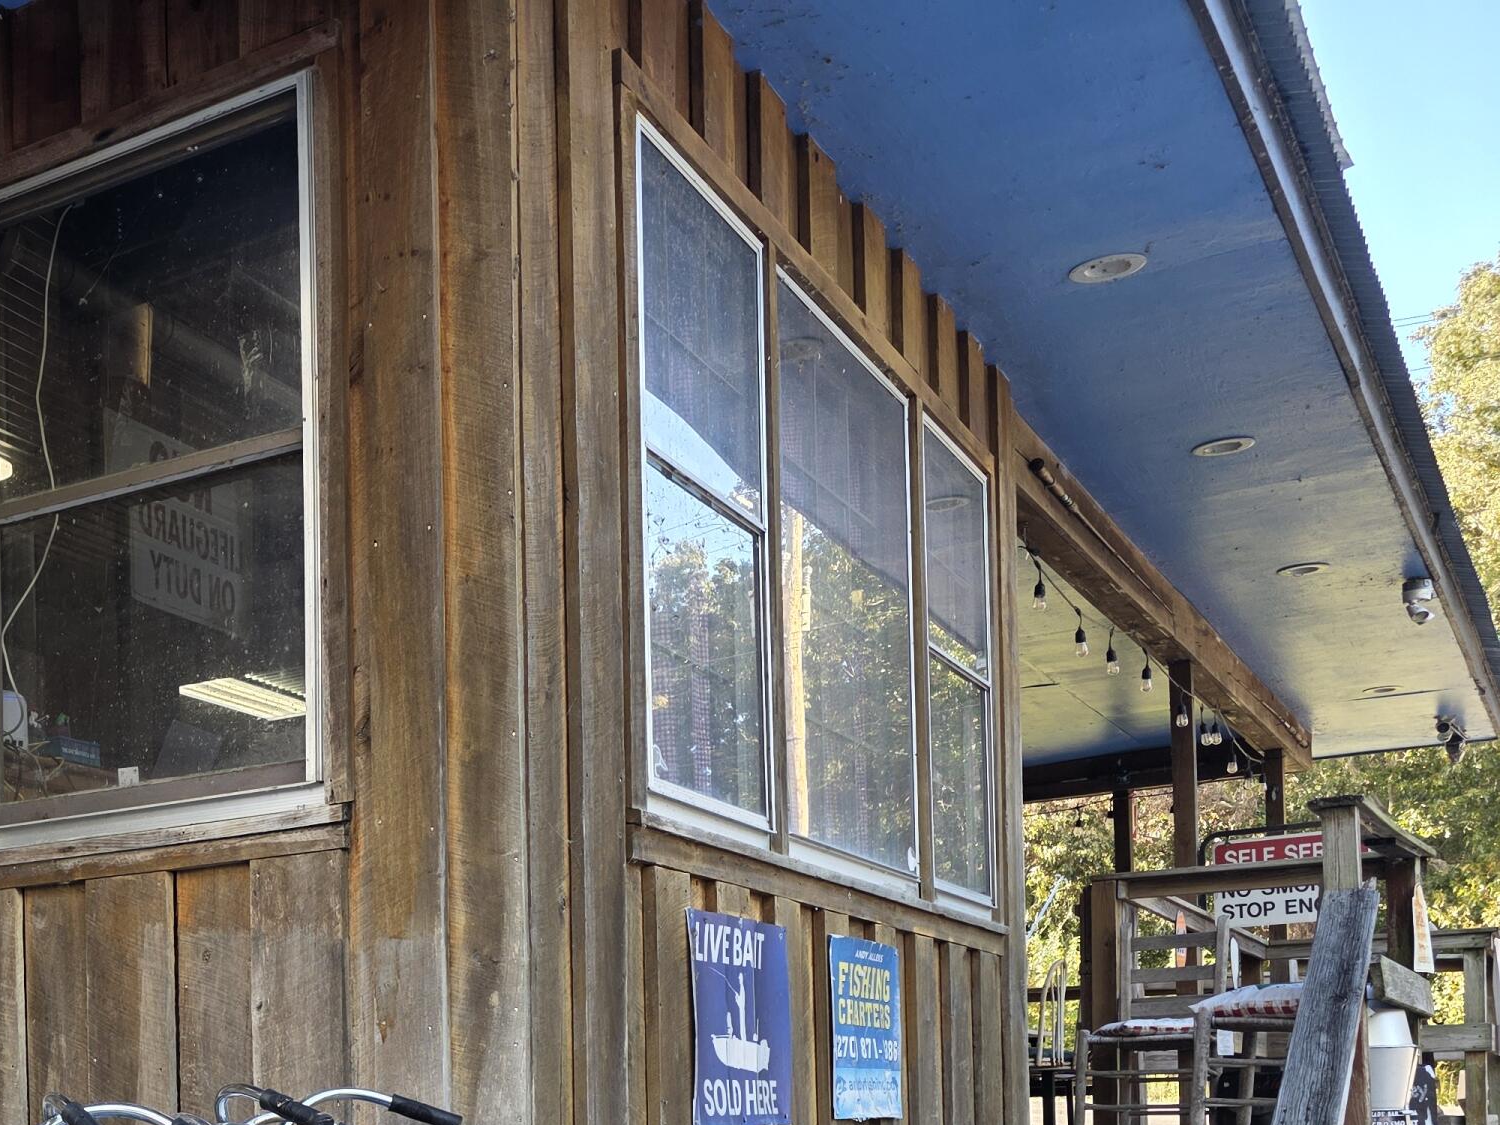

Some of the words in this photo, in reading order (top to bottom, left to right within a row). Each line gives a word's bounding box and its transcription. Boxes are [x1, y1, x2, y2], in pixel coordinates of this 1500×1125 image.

[1222, 901, 1276, 919] STOP
[694, 921, 730, 965] LIVE
[733, 928, 765, 970] BAIT
[838, 961, 890, 1003] FISHING
[838, 999, 891, 1030] CHARTERS
[703, 1079, 742, 1117] SOLD
[746, 1080, 779, 1116] HERE
